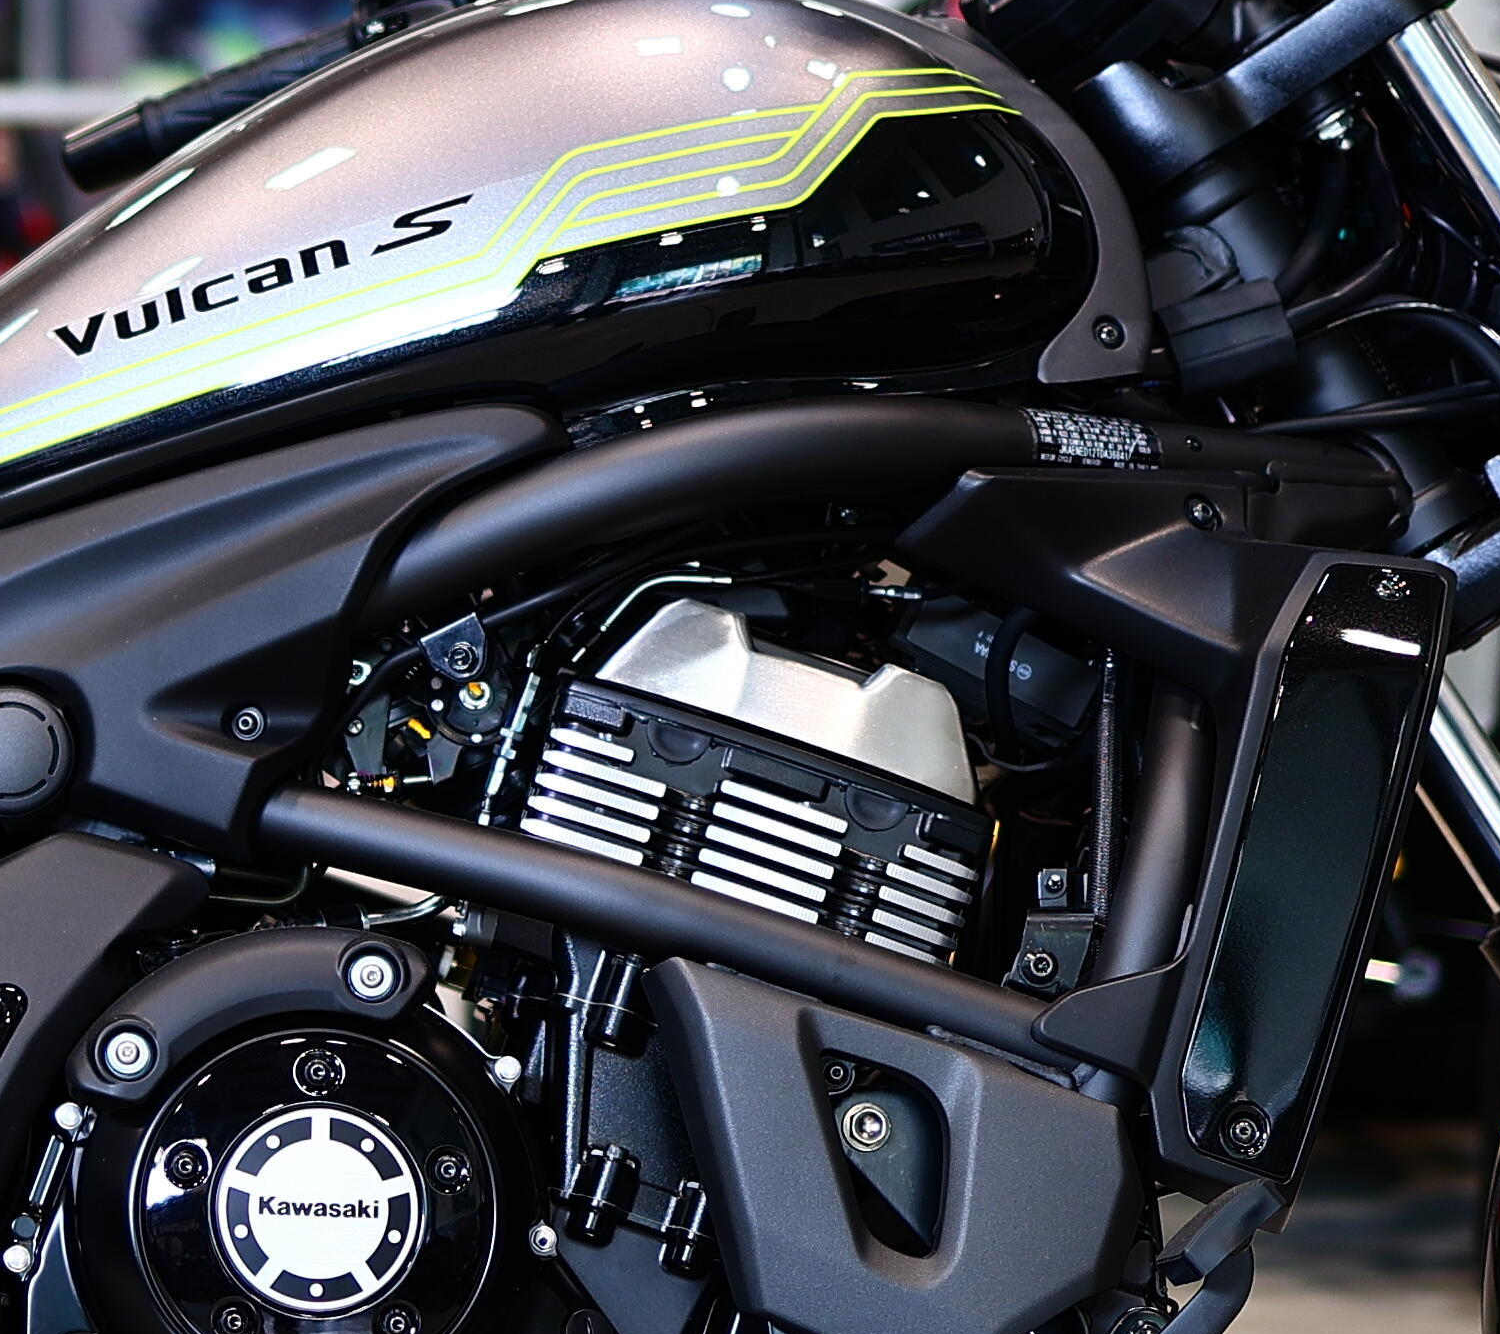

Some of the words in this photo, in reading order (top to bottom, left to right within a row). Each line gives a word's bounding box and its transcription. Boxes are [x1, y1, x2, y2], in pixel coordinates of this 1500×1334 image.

[52, 239, 354, 357] Vulcan
[371, 193, 474, 255] S
[257, 1196, 380, 1219] Kawasaki
